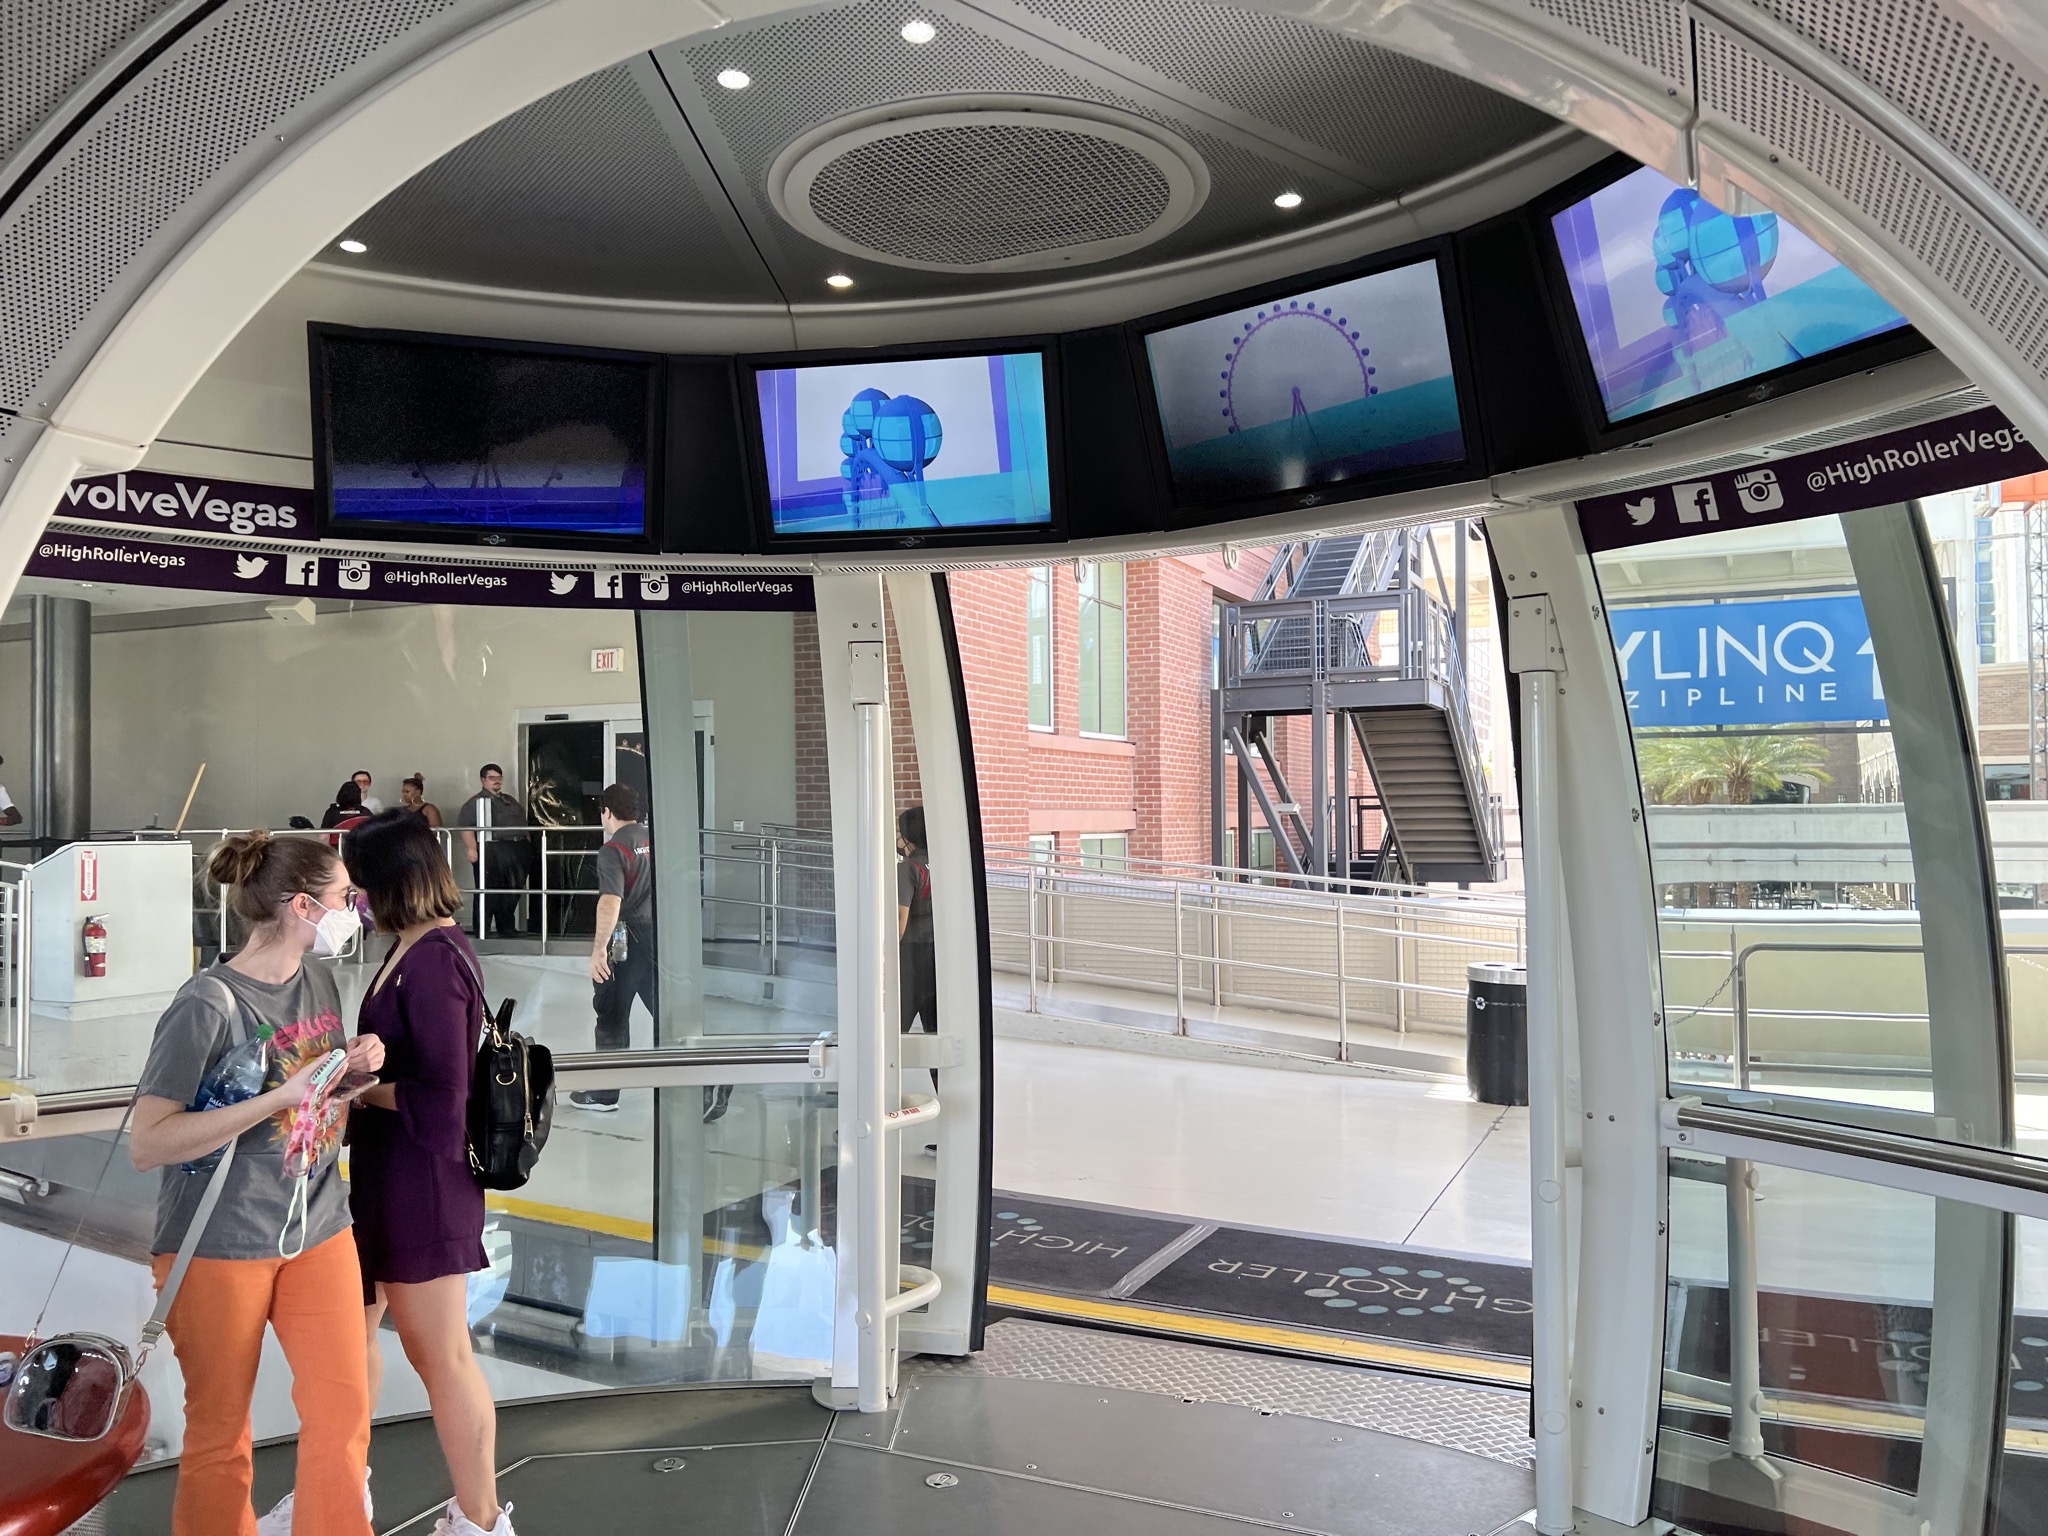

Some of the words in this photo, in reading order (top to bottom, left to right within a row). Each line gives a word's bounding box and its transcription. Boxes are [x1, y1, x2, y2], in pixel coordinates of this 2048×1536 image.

[1806, 425, 2030, 493] @HighRollerVega
[64, 473, 298, 535] volveVegas
[39, 543, 186, 569] @HighRollerVegas
[384, 570, 508, 588] @HighRollerVegas
[681, 580, 794, 596] @HighRollerVegas
[595, 652, 615, 670] EXIT
[1617, 620, 1836, 682] YLINQ
[1625, 682, 1838, 710] ZIPLINE
[995, 1229, 1129, 1259] HIGH
[1207, 1258, 1430, 1301] ROLLER
[1444, 1291, 1534, 1315] GH
